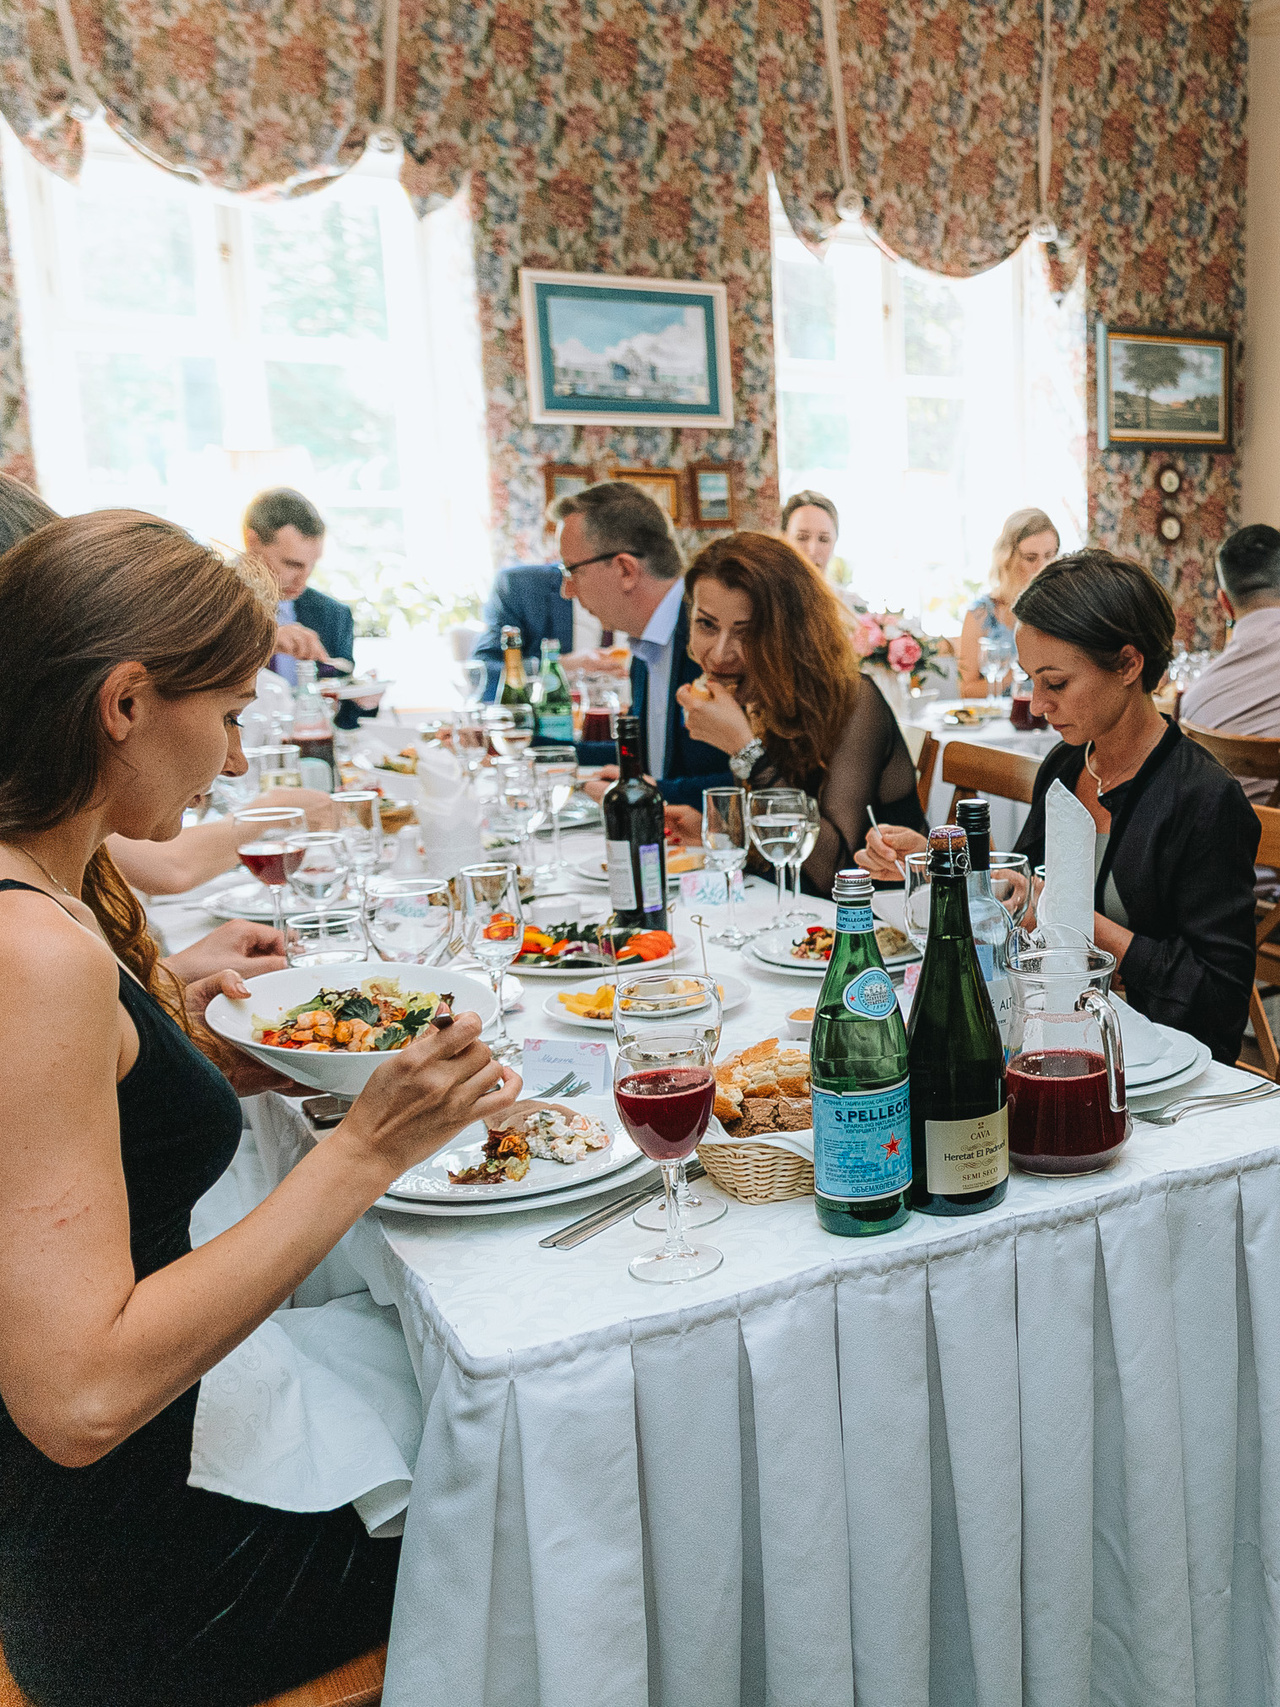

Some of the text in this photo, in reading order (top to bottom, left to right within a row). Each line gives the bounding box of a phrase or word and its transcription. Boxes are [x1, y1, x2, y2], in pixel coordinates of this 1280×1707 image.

[970, 1129, 991, 1141] CAVA
[944, 1152, 975, 1161] Heretat
[976, 1148, 984, 1158] El
[962, 1172, 981, 1181] SEMI
[982, 1166, 999, 1177] SECO
